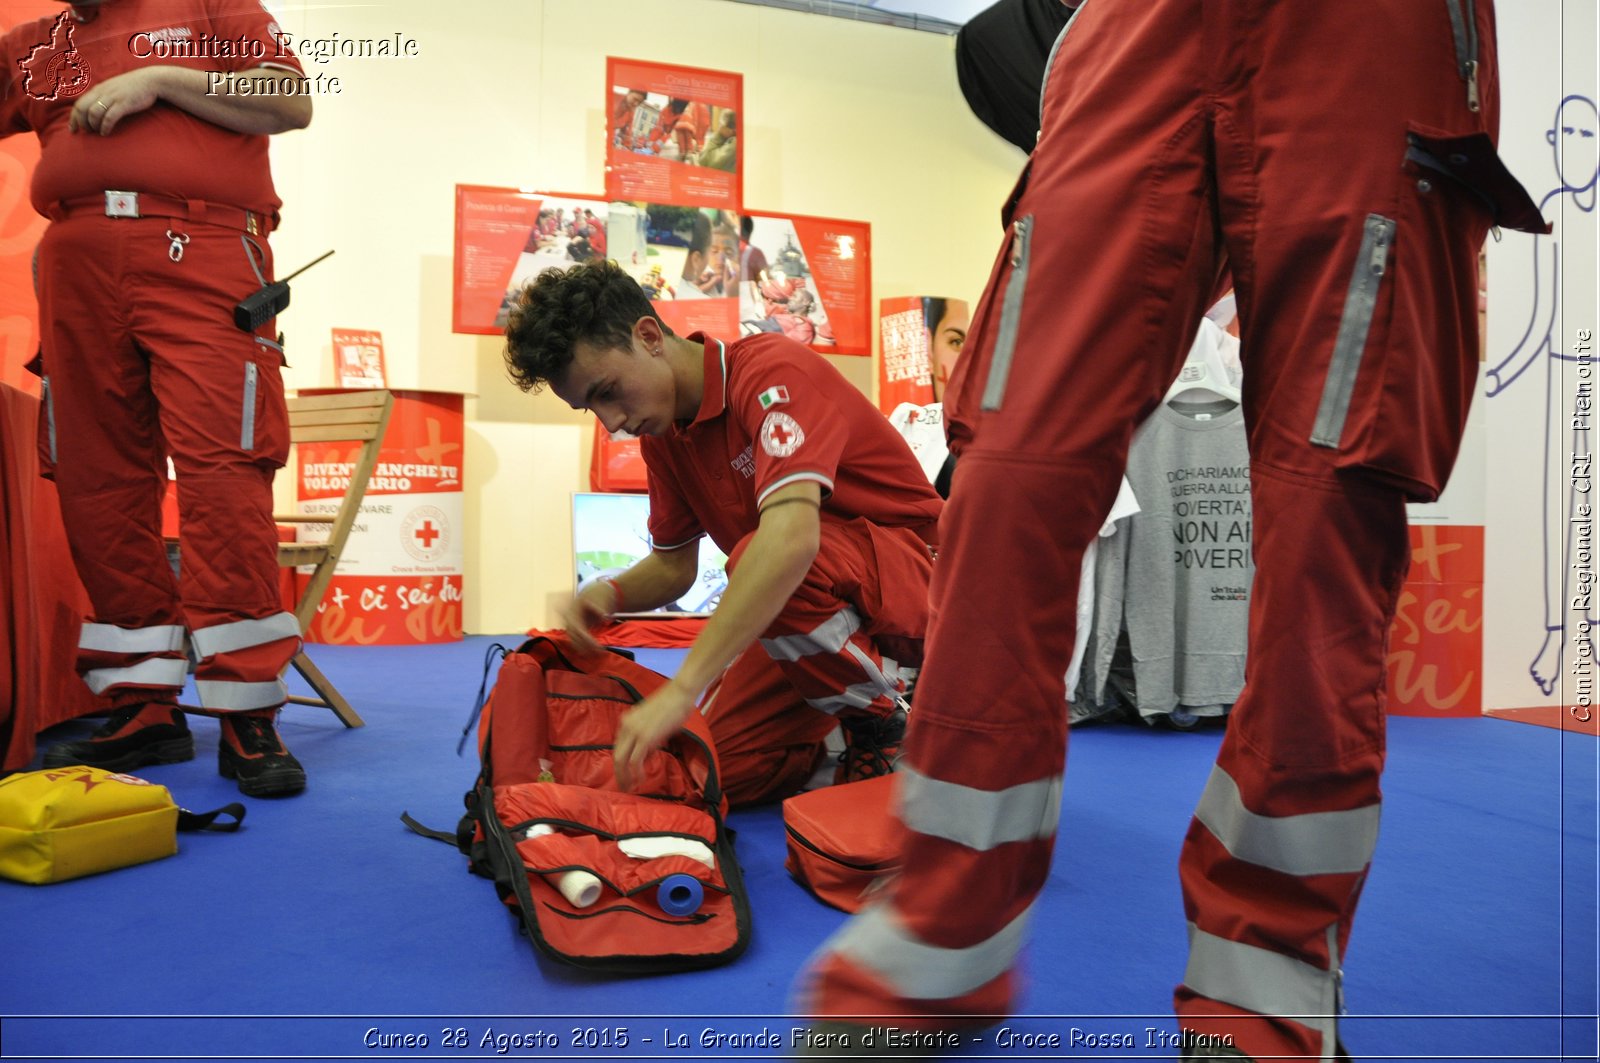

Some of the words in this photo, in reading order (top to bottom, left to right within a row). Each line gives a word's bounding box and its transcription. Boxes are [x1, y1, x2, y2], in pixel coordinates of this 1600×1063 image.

[887, 366, 930, 383] FARE
[376, 463, 437, 478] ANCHE
[441, 466, 458, 479] TU
[303, 477, 411, 491] VOLONARIO
[1218, 483, 1250, 494] ALLA
[304, 504, 317, 513] QUI
[1173, 521, 1218, 544] NON
[1174, 549, 1249, 569] POVERI
[360, 585, 388, 611] ci
[396, 584, 434, 610] sei
